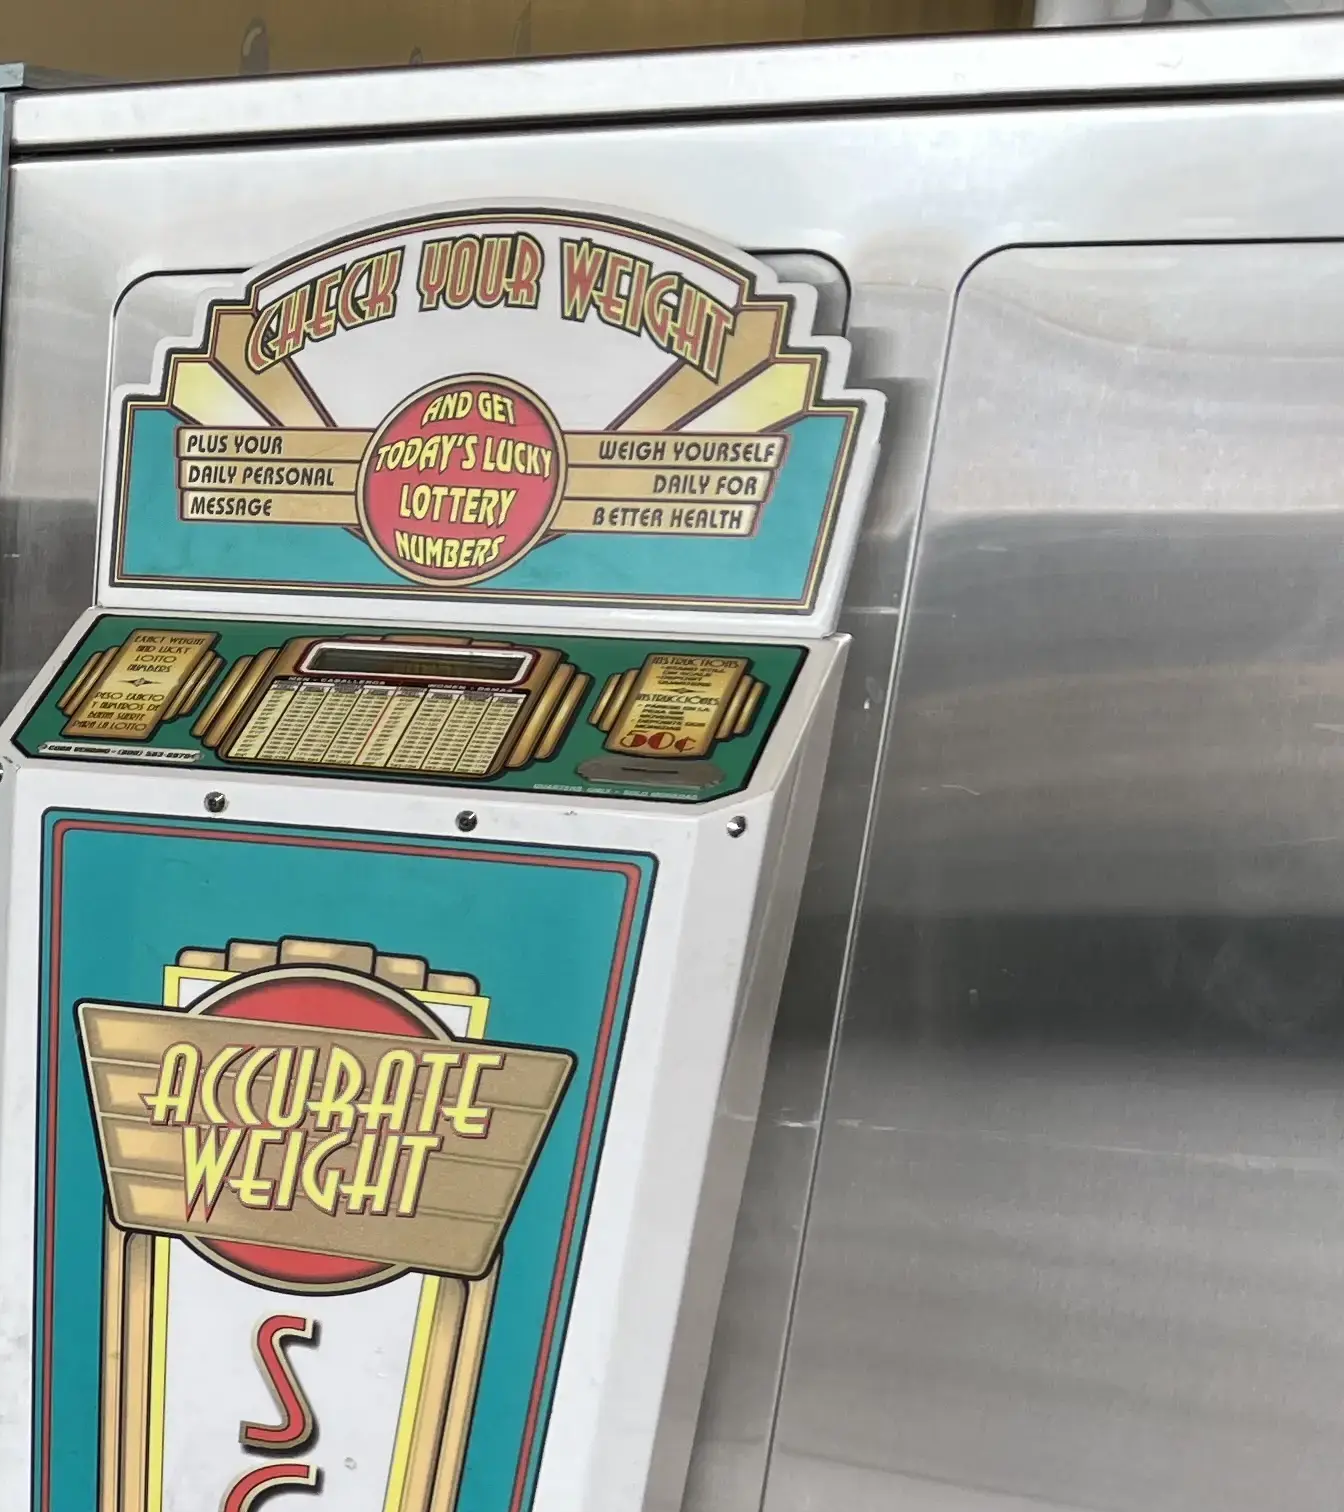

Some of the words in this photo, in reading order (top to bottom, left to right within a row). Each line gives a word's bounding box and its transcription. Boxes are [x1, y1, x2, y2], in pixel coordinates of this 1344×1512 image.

[246, 244, 406, 374] CHECK
[419, 232, 544, 310] YOUR
[558, 237, 740, 383] WEIGHT
[423, 394, 474, 424] AND
[478, 390, 517, 424] GET
[187, 434, 225, 454] PLUS
[233, 435, 283, 455] YOUR
[599, 440, 665, 461] WEIGH
[673, 441, 775, 465] YOURSELF
[376, 435, 478, 472] TODAY'S
[481, 438, 553, 478] LUCKY
[188, 464, 236, 484] DAILY
[241, 465, 335, 487] PERSONAL
[653, 474, 709, 495] DAILY
[717, 476, 758, 496] FOR
[191, 495, 273, 516] MESSAGE
[399, 485, 518, 528] LOTTERY
[594, 505, 663, 528] BETTER
[671, 508, 743, 530] HEALTH
[394, 531, 505, 568] NUMBERS
[134, 635, 165, 643] EXACT
[169, 637, 207, 645] WEIGHT
[158, 646, 192, 654] LUCKY
[127, 664, 173, 673] NUMBERS
[134, 655, 178, 663] LOTTO
[652, 656, 739, 669] INSTRUCTIONS
[99, 702, 144, 711] NUMEROS
[126, 693, 164, 702] EXACTO
[72, 720, 97, 729] PARA
[97, 721, 109, 730] LA
[109, 722, 147, 731] LOTTO
[115, 712, 146, 721] SUERTE
[141, 1041, 507, 1138] ACCURATE
[182, 1125, 442, 1223] WEIGHT
